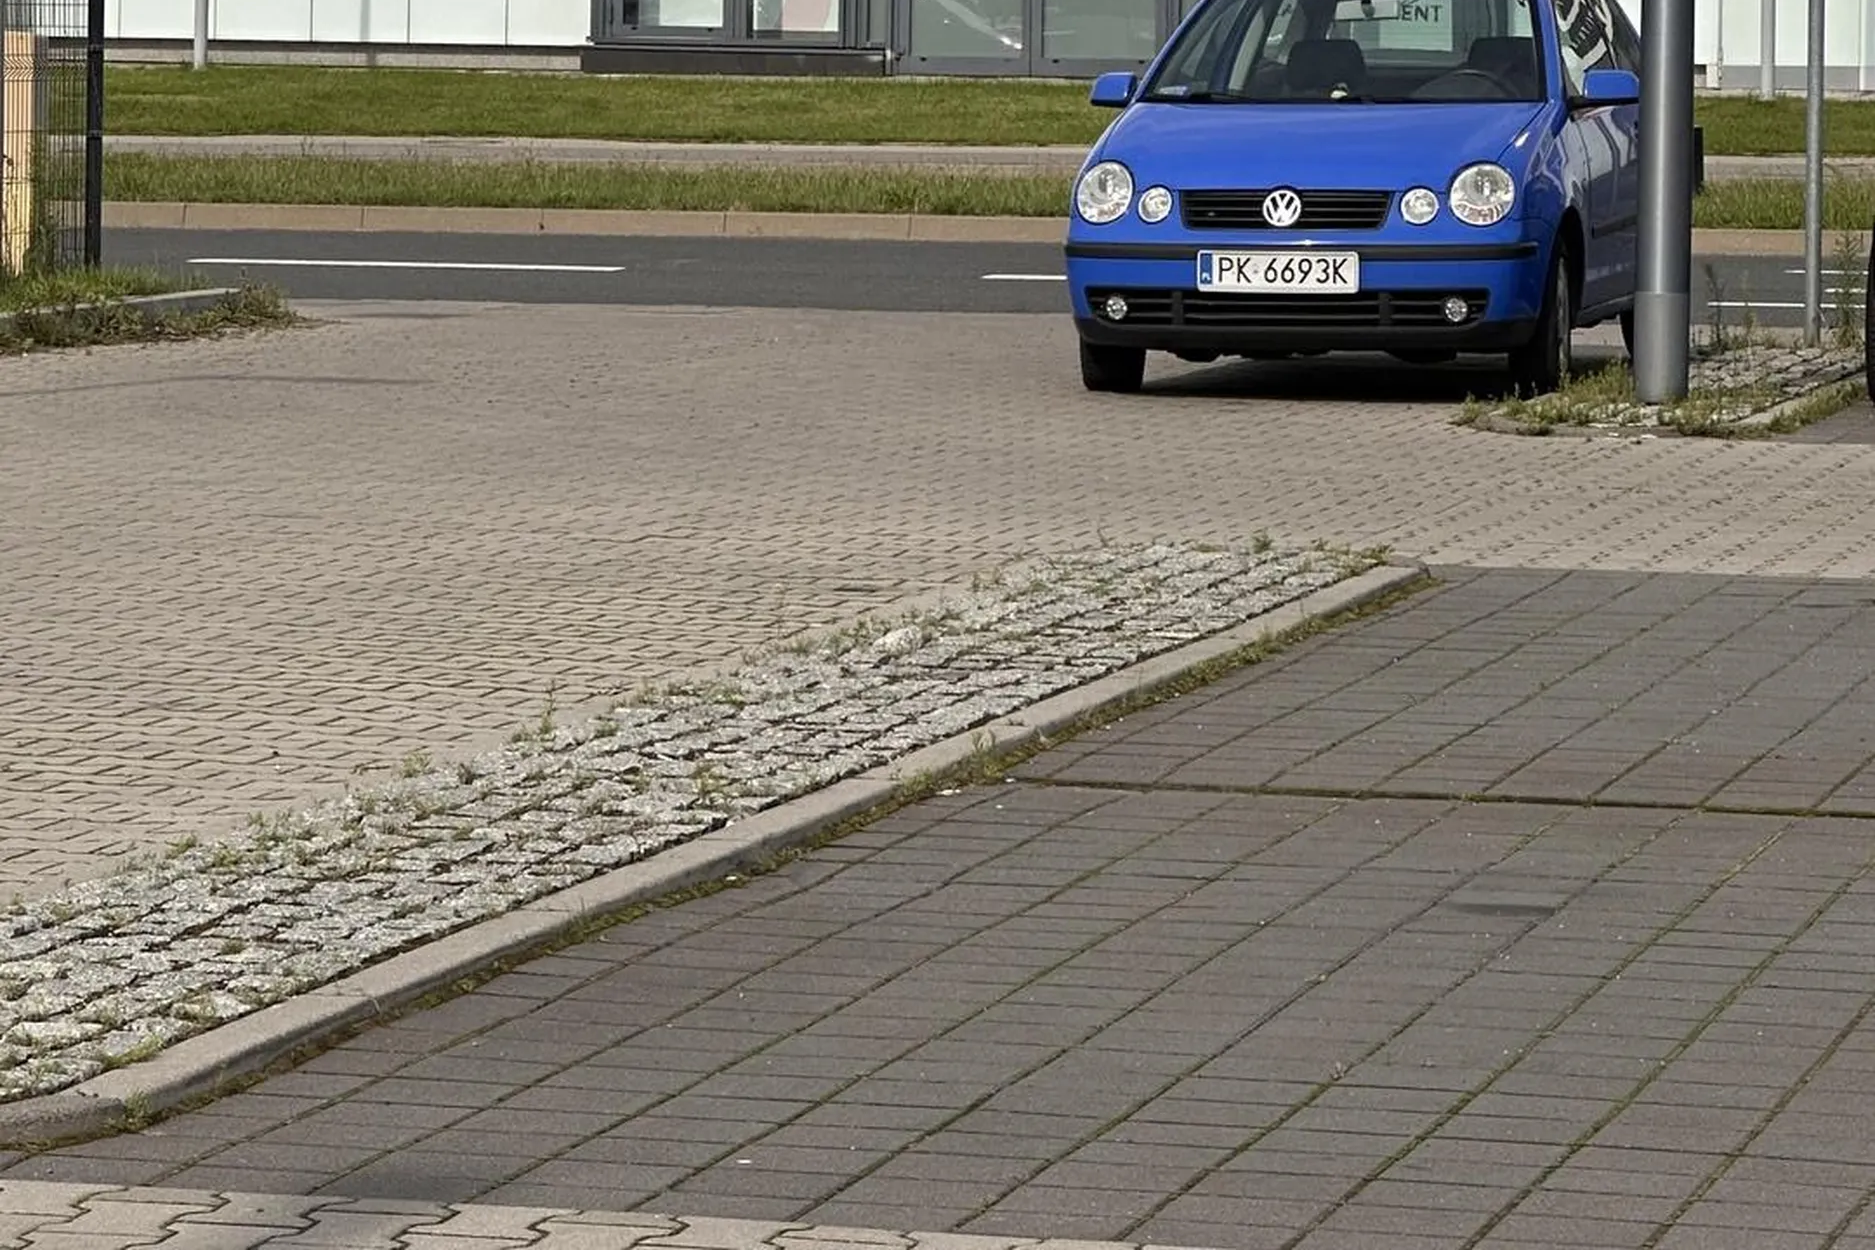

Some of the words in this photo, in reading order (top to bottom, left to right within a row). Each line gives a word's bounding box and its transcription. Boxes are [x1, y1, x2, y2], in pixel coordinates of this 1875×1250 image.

[1401, 4, 1443, 22] ENT
[1218, 257, 1252, 283] PK
[1264, 257, 1348, 284] 6693K
